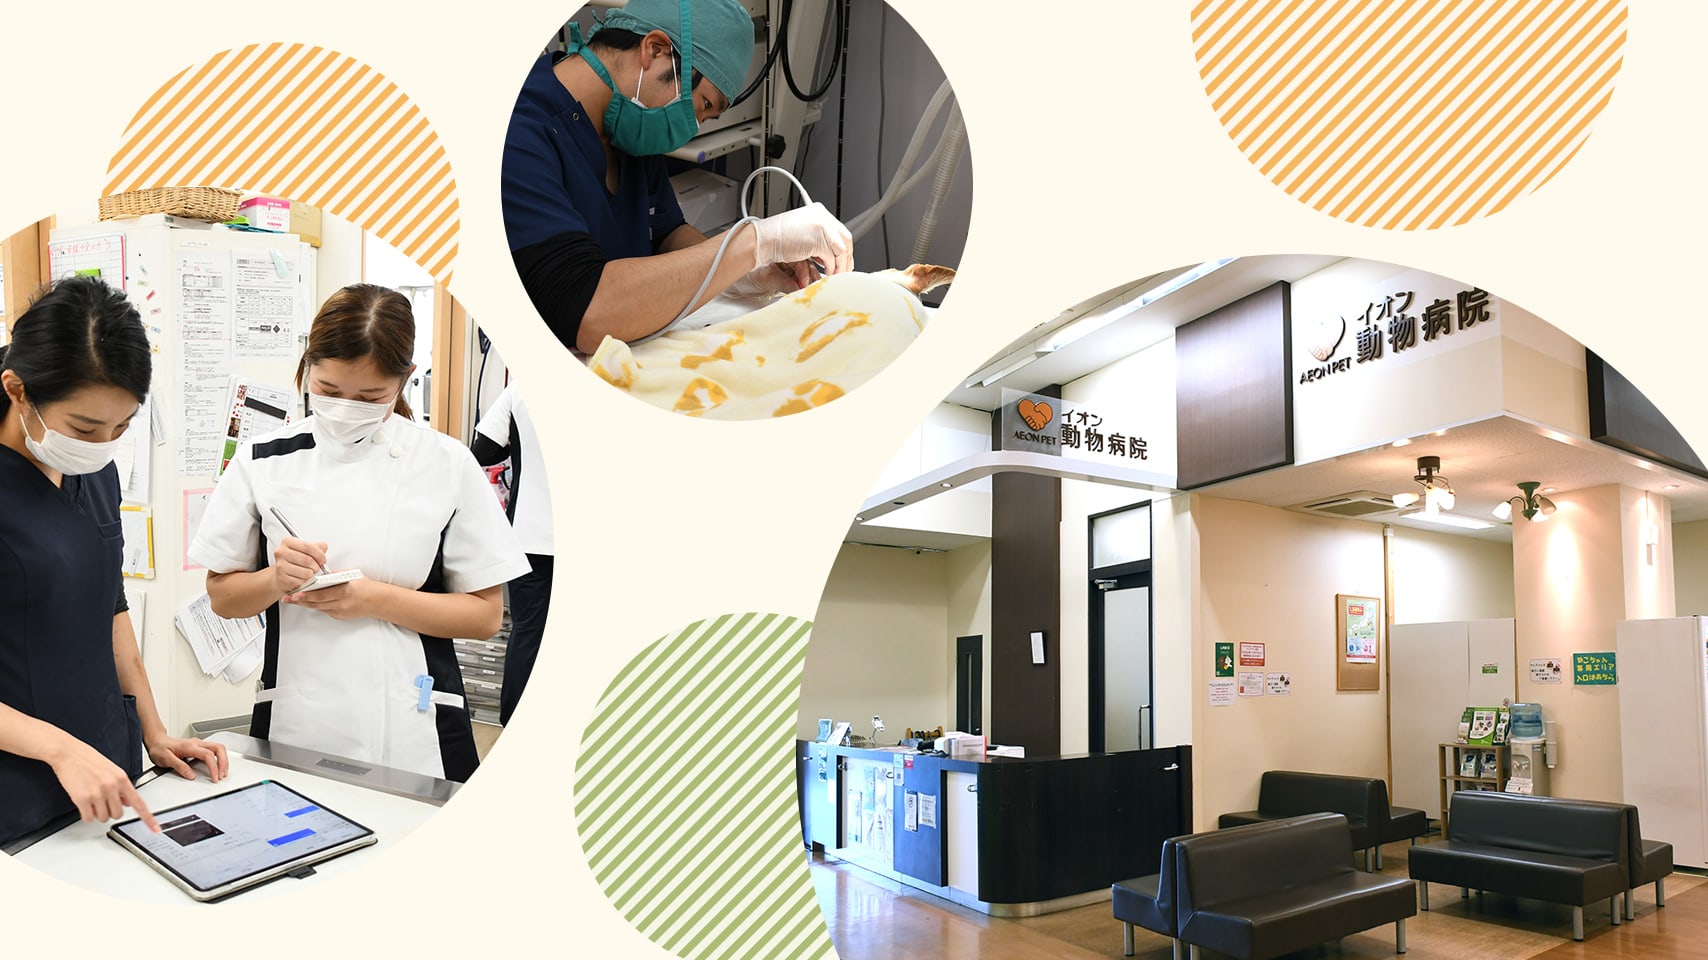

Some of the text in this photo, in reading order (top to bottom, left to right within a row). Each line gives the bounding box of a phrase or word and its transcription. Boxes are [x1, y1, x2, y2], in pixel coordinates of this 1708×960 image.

[1357, 291, 1415, 325] イオン
[1356, 287, 1490, 364] 動物病院
[1299, 356, 1352, 384] AEON PET
[1062, 409, 1103, 427] イオン
[1013, 431, 1056, 446] AEON PET
[1061, 424, 1148, 460] 動物病院
